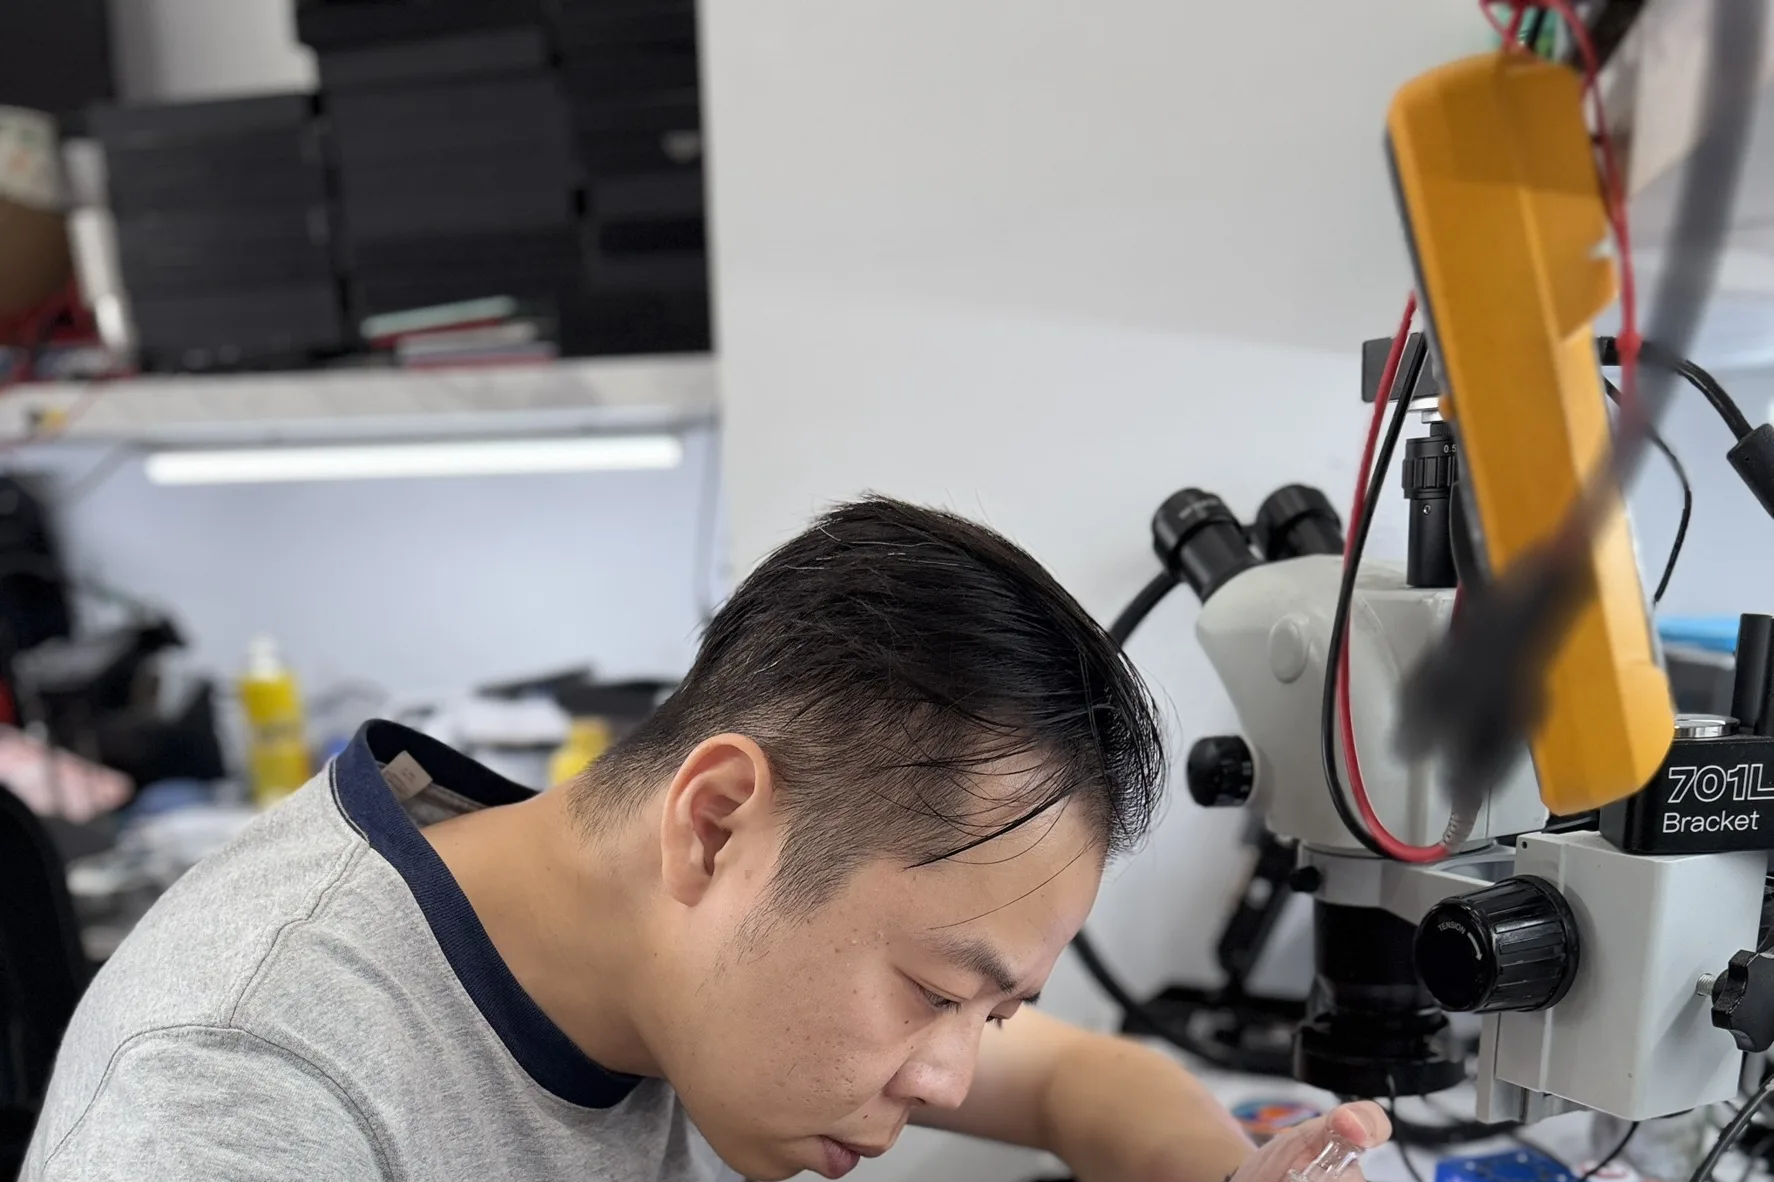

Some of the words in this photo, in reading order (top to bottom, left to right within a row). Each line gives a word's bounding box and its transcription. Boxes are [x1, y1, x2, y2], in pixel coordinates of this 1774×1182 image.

[1443, 444, 1457, 453] 0.5
[1667, 764, 1774, 803] 701L
[1662, 811, 1760, 833] Bracket
[1437, 921, 1466, 934] TENSION
